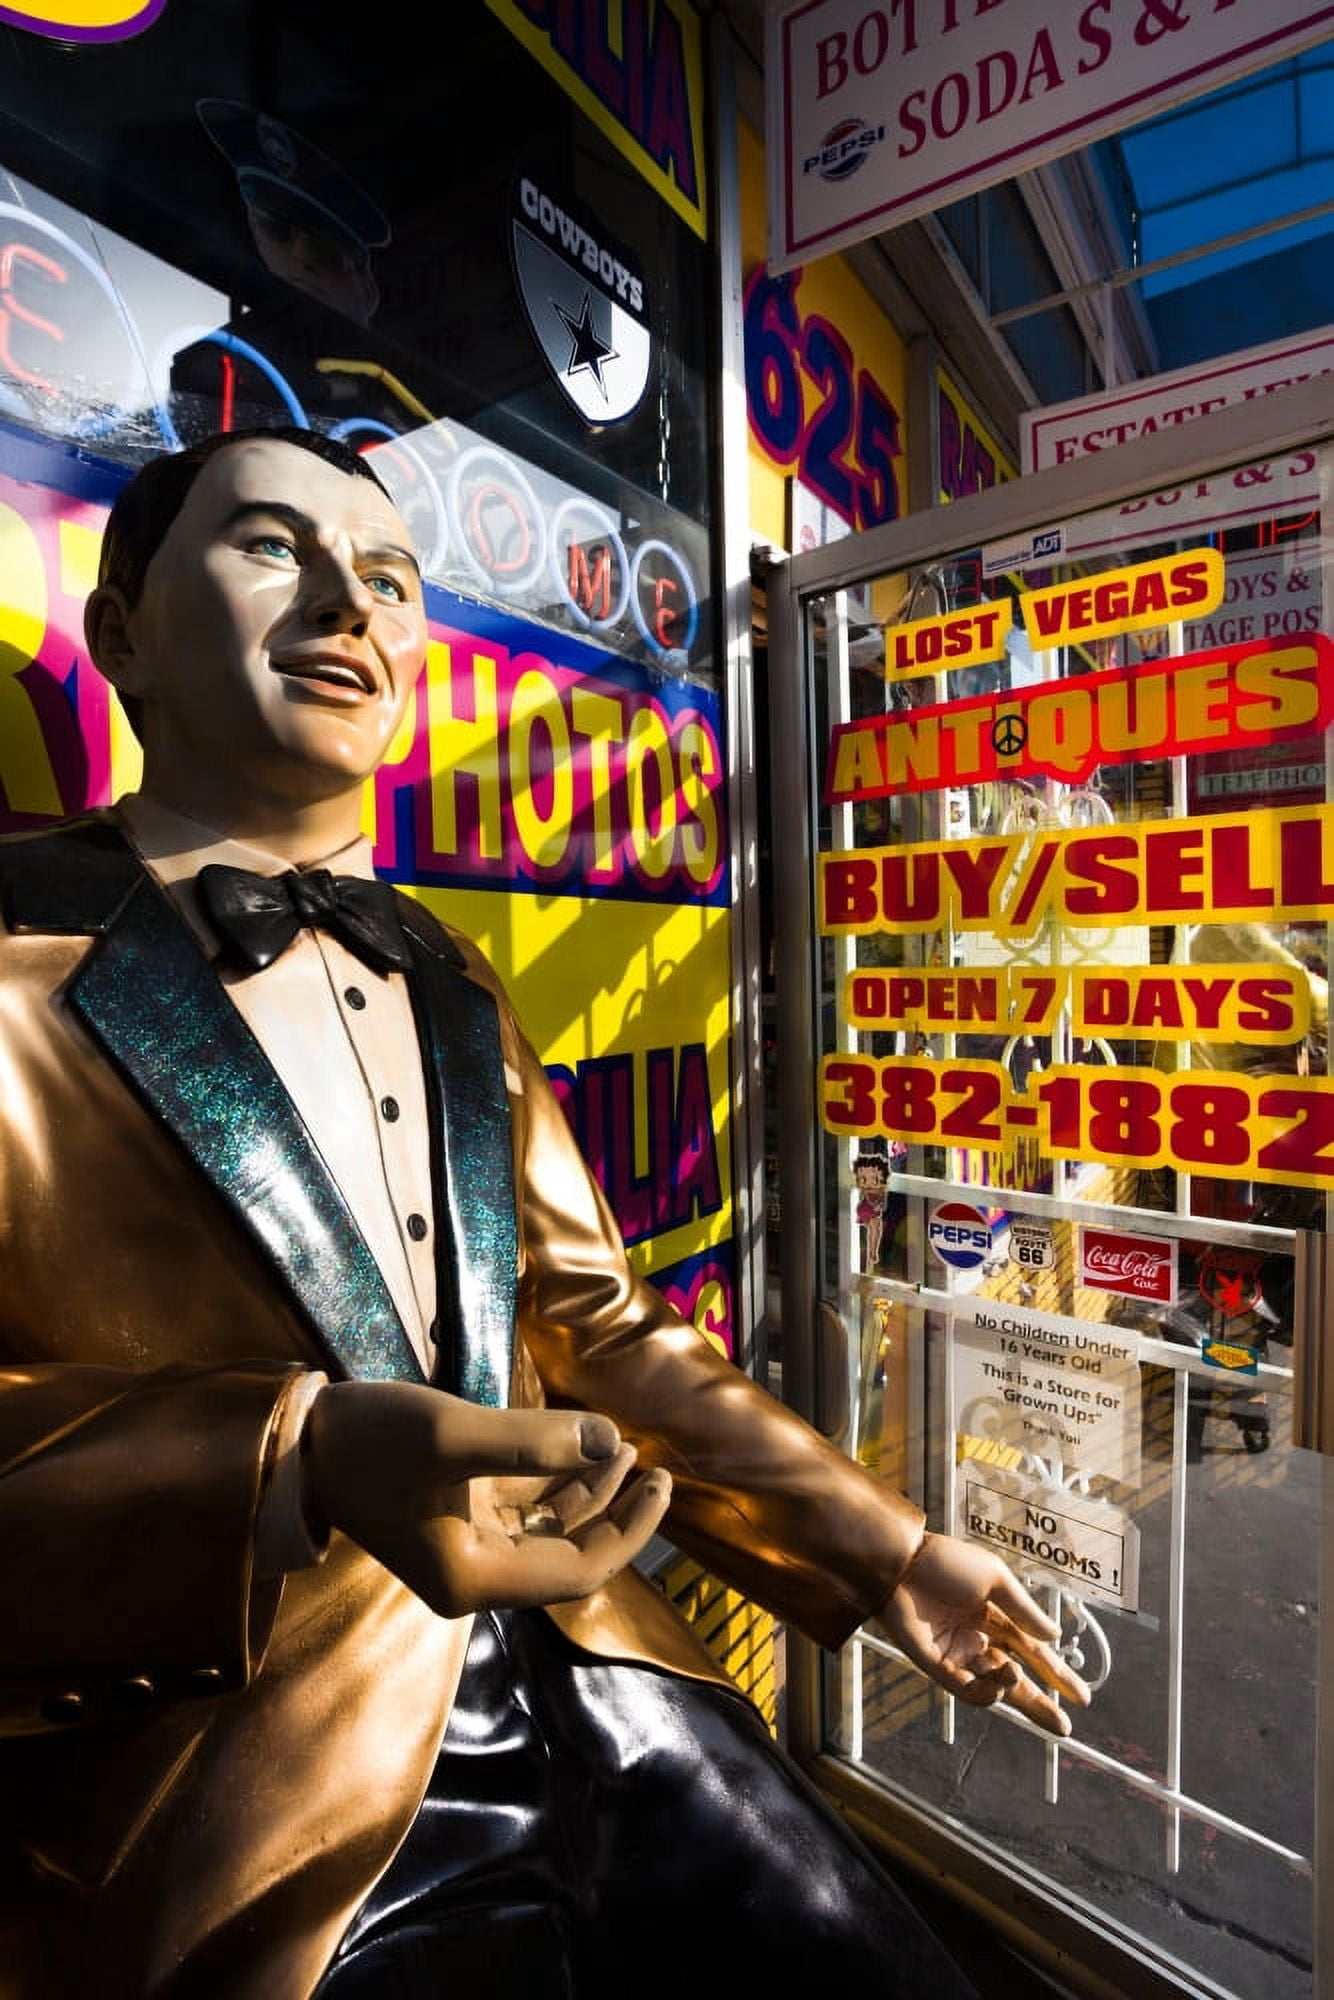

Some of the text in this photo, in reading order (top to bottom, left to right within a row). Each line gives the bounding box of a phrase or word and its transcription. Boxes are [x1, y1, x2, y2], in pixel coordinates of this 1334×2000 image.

[803, 125, 886, 177] PEPSI
[521, 178, 643, 312] COWBOYS
[742, 260, 904, 530] 625
[1036, 534, 1060, 553] ADT
[1286, 568, 1311, 594] &
[895, 561, 1208, 669] LOST VEGAS
[832, 645, 1320, 795] ANTIQUES
[825, 817, 1334, 926] BUY/SELL
[852, 977, 1296, 1032] OPEN 7 DAYS
[824, 1062, 1334, 1176] 382-1882
[929, 1222, 993, 1250] PEPSI
[1019, 1247, 1043, 1265] 66
[975, 1313, 1130, 1360] No Children Under
[1000, 1338, 1101, 1374] 16 Years Old
[982, 1362, 1121, 1409] This is a Store for
[1025, 1508, 1057, 1535] NO
[970, 1514, 1119, 1588] RESTROOMS !
